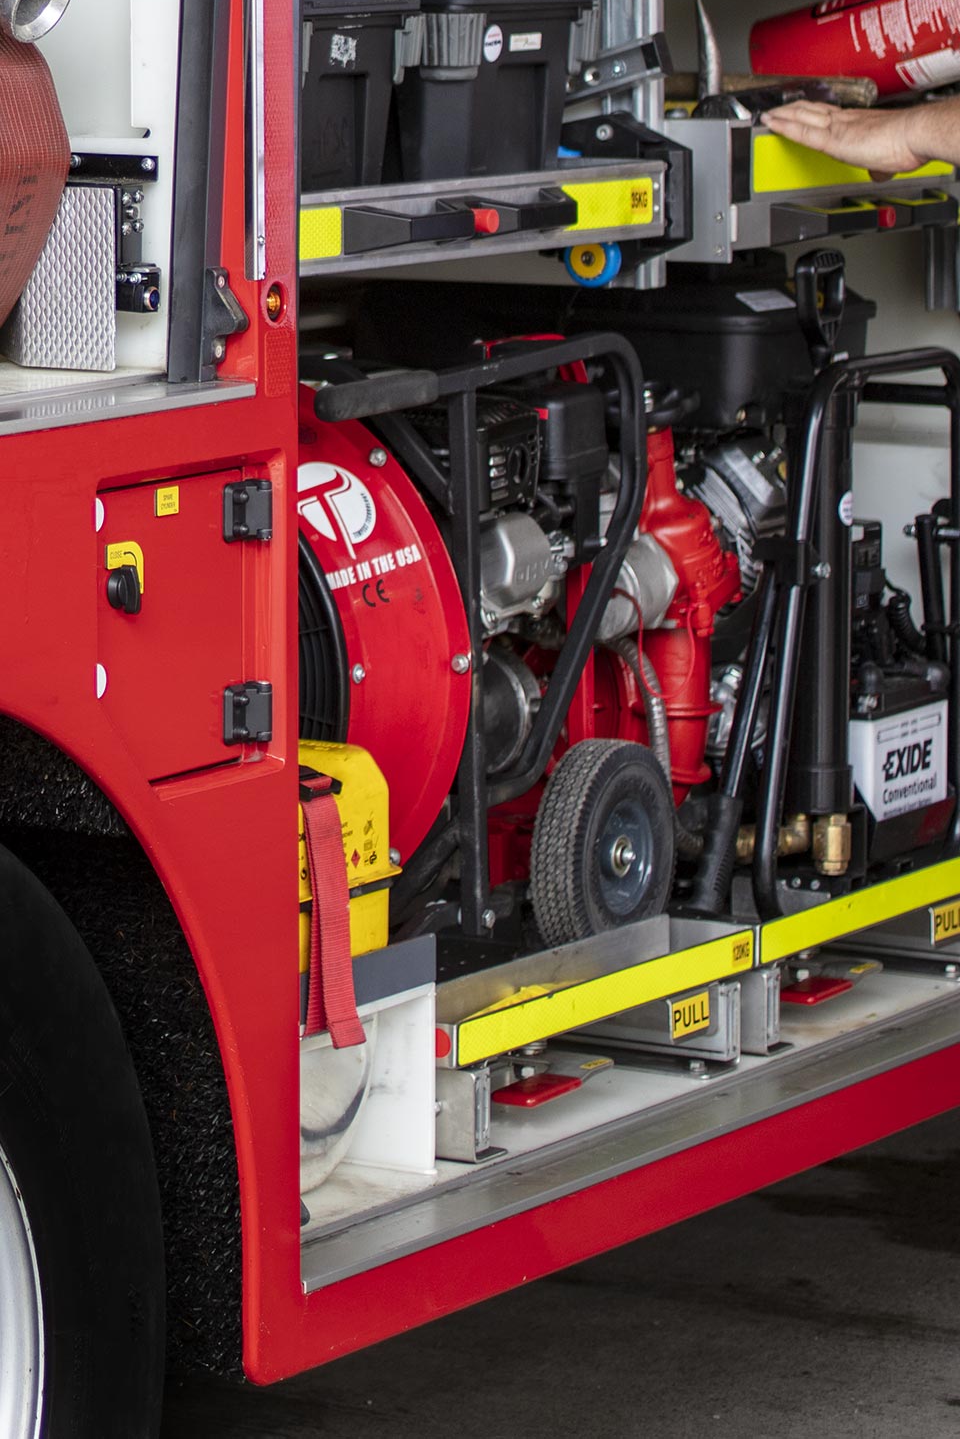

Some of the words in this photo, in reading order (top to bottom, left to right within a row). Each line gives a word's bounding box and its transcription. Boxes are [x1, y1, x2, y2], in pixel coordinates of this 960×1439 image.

[631, 191, 648, 208] 35KG
[325, 566, 357, 591] MADE
[356, 561, 372, 582] IN
[371, 552, 396, 576] THE
[395, 543, 422, 568] USA
[883, 738, 933, 783] EXIDE
[882, 771, 938, 805] Conventional
[733, 941, 751, 962] 120KG
[673, 1000, 710, 1032] PULL
